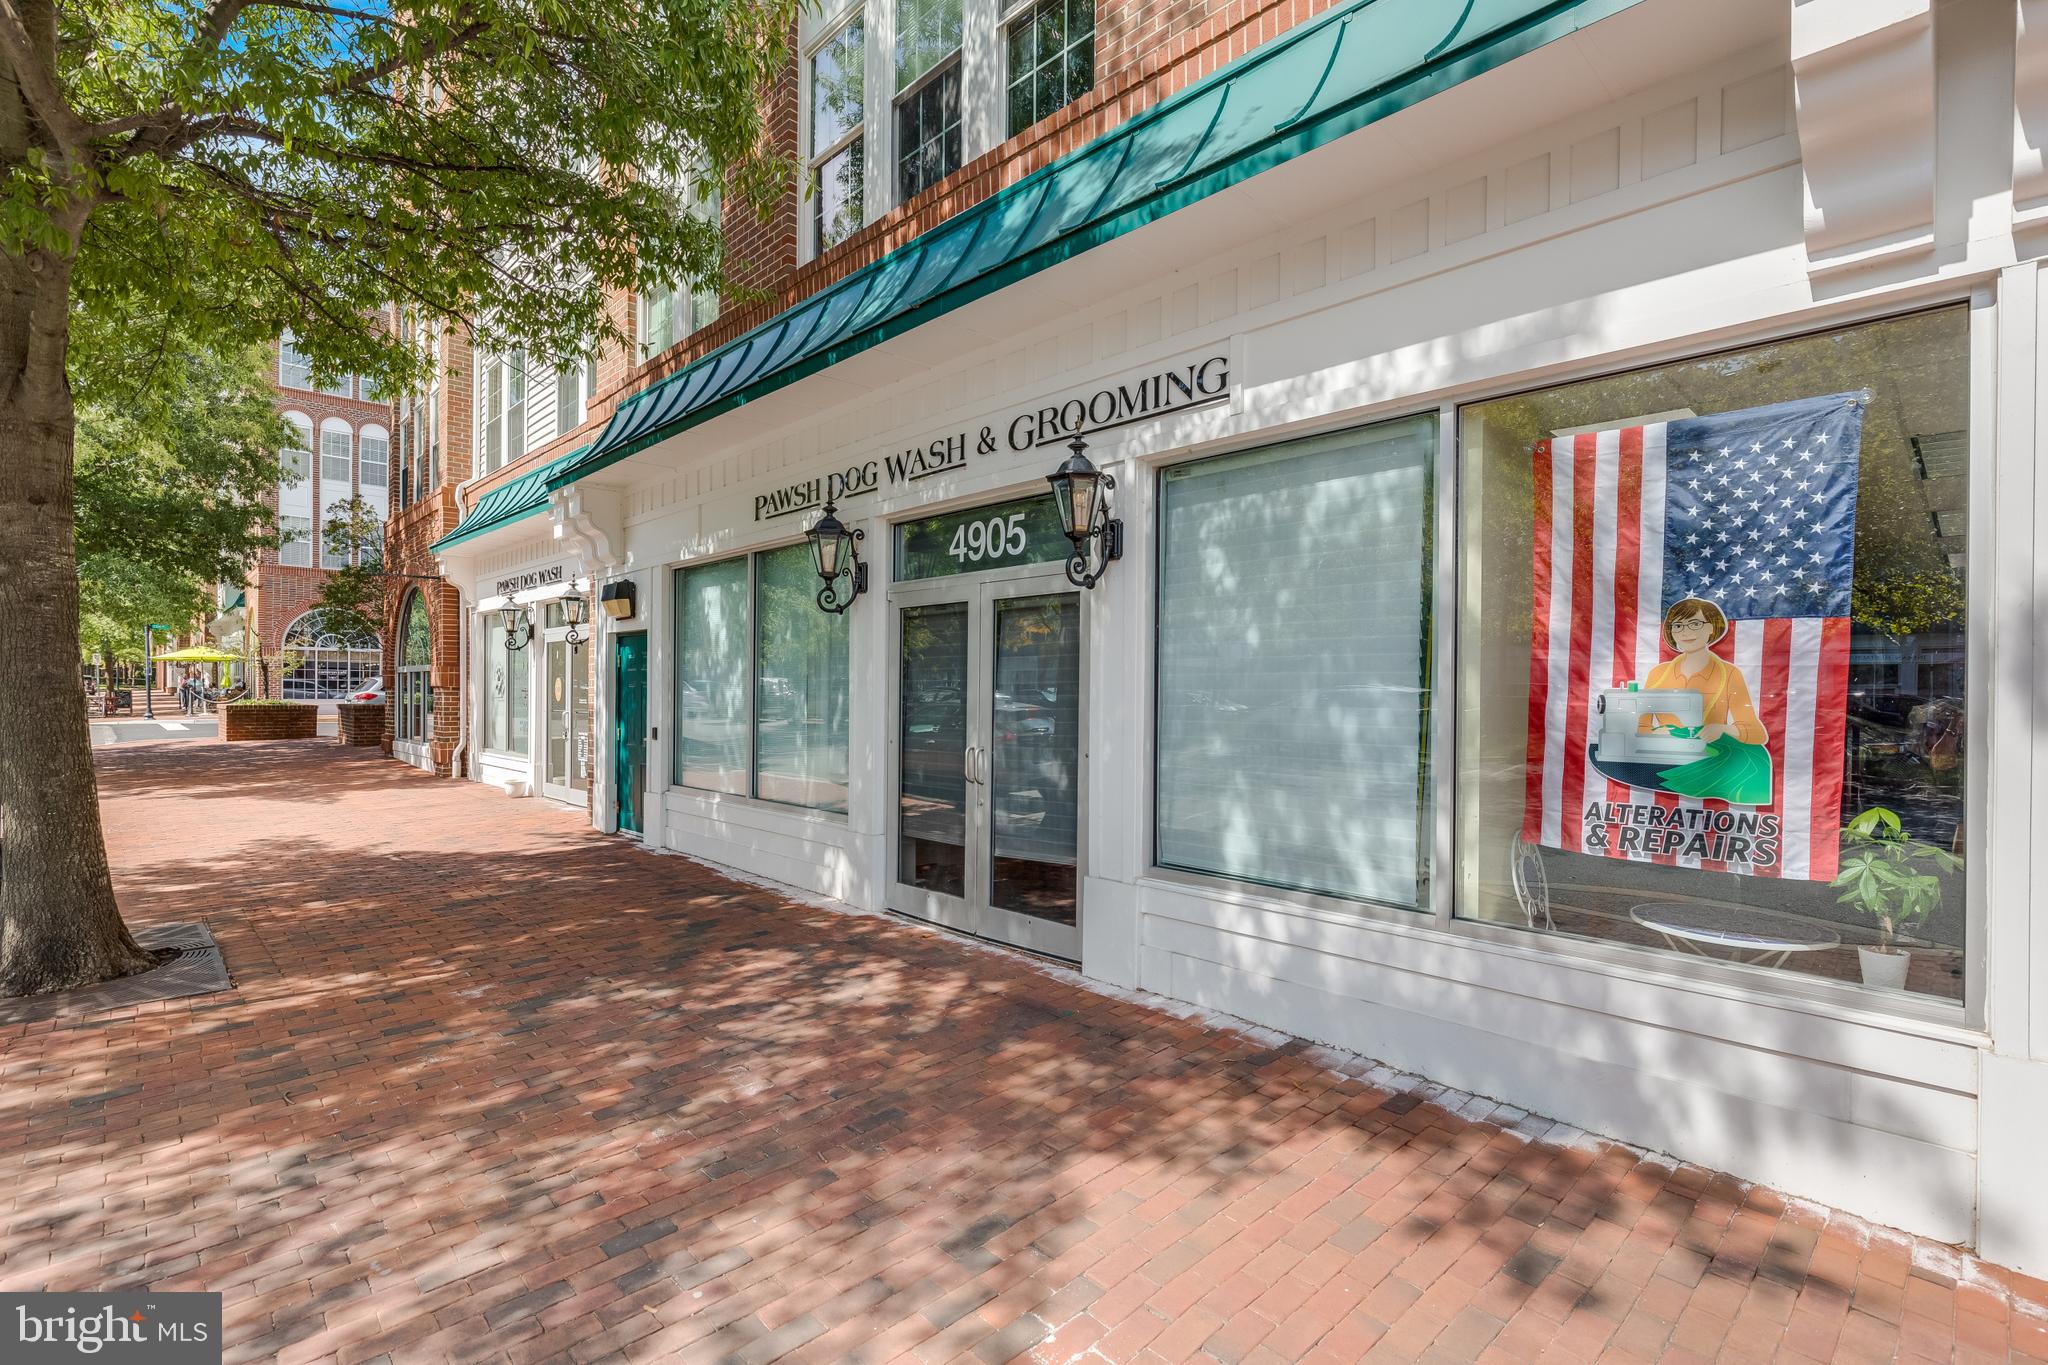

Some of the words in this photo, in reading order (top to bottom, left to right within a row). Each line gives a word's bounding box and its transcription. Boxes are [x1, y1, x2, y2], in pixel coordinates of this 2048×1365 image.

[754, 477, 820, 522] PAWSH
[827, 461, 878, 501] DOG
[884, 433, 967, 485] WASH
[977, 426, 998, 455] &
[1008, 357, 1230, 451] GROOMING
[949, 513, 1026, 563] 4905
[520, 572, 537, 590] DOG
[538, 565, 562, 584] WASH
[1583, 800, 1780, 838] ALTERATIONS
[1585, 823, 1611, 850] &
[1618, 825, 1779, 867] REPAIRS
